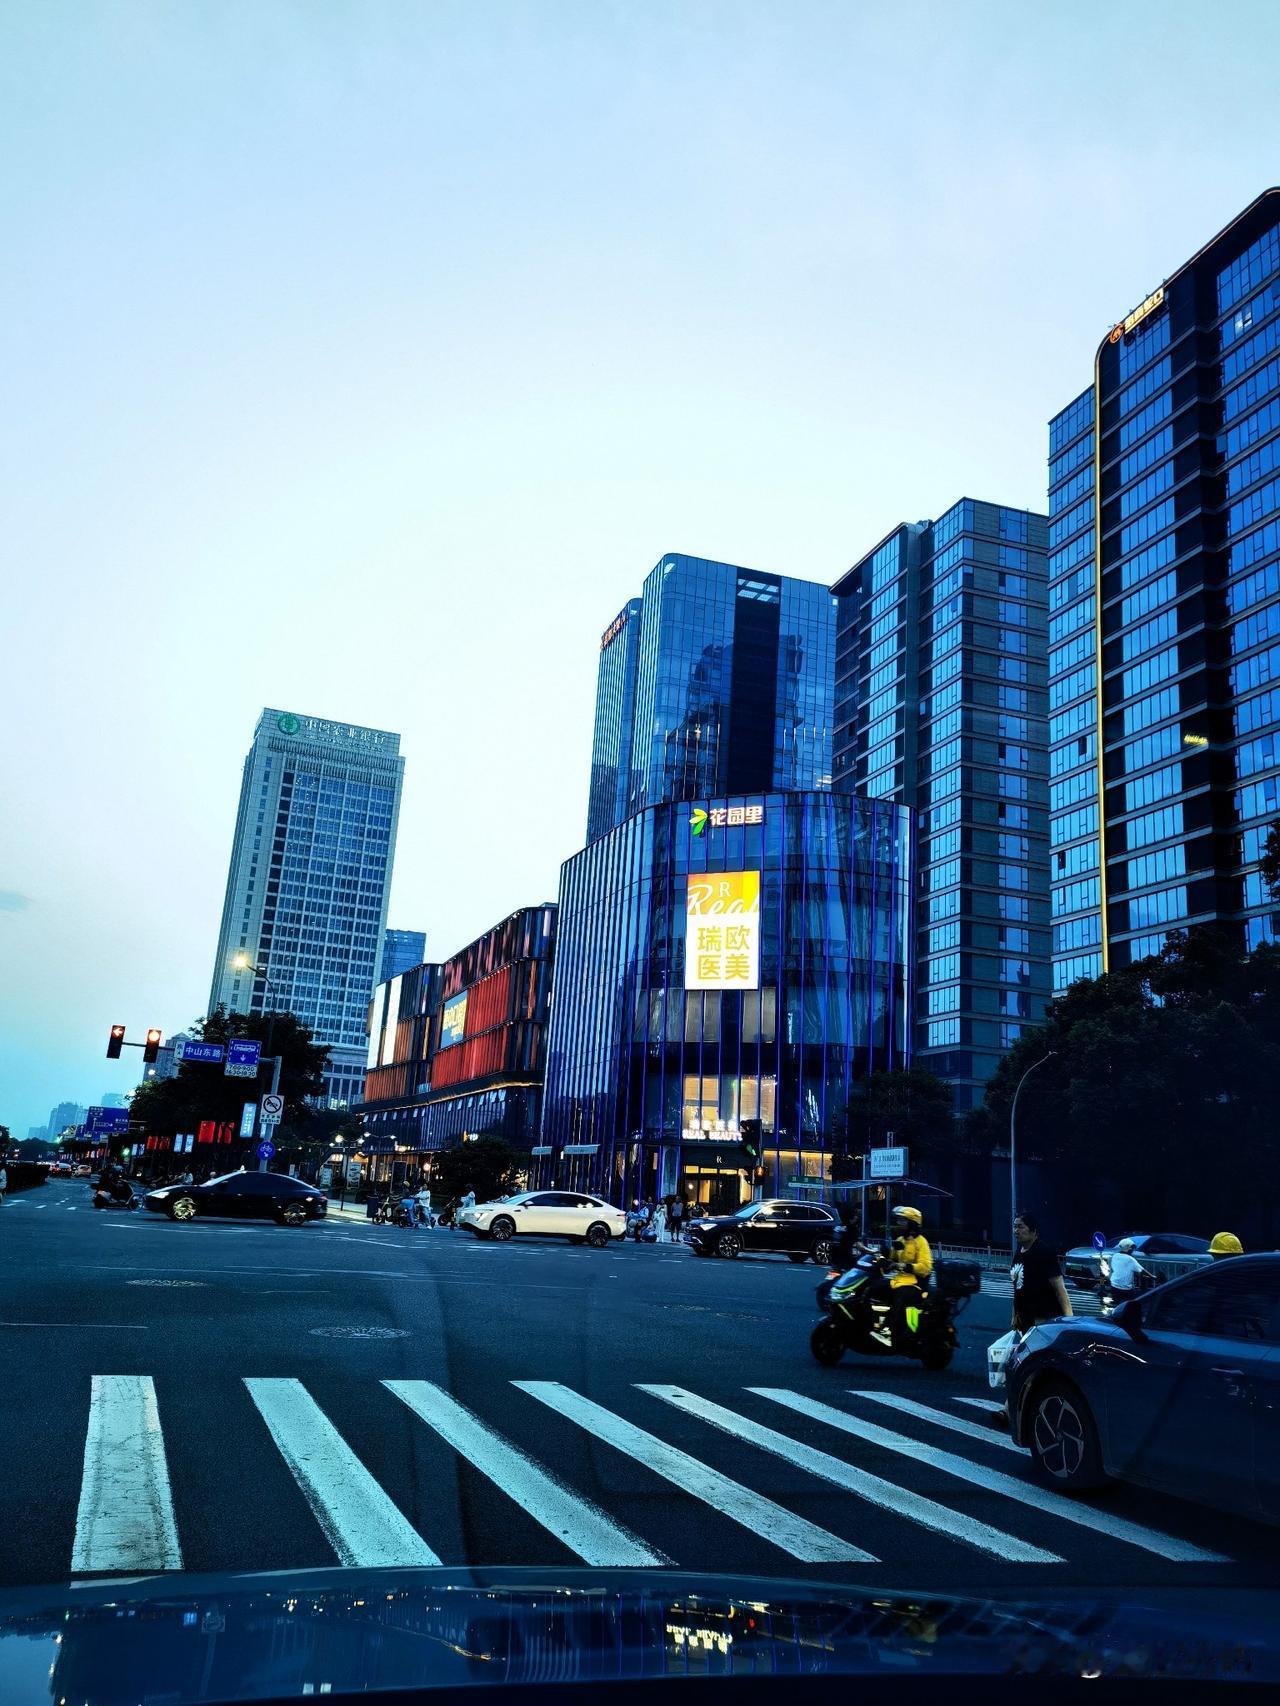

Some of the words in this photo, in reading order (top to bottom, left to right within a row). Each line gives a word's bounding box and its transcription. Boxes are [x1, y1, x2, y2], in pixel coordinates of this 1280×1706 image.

[710, 806, 763, 826] 花园里
[719, 882, 731, 897] R
[185, 1046, 222, 1058] 中山东路
